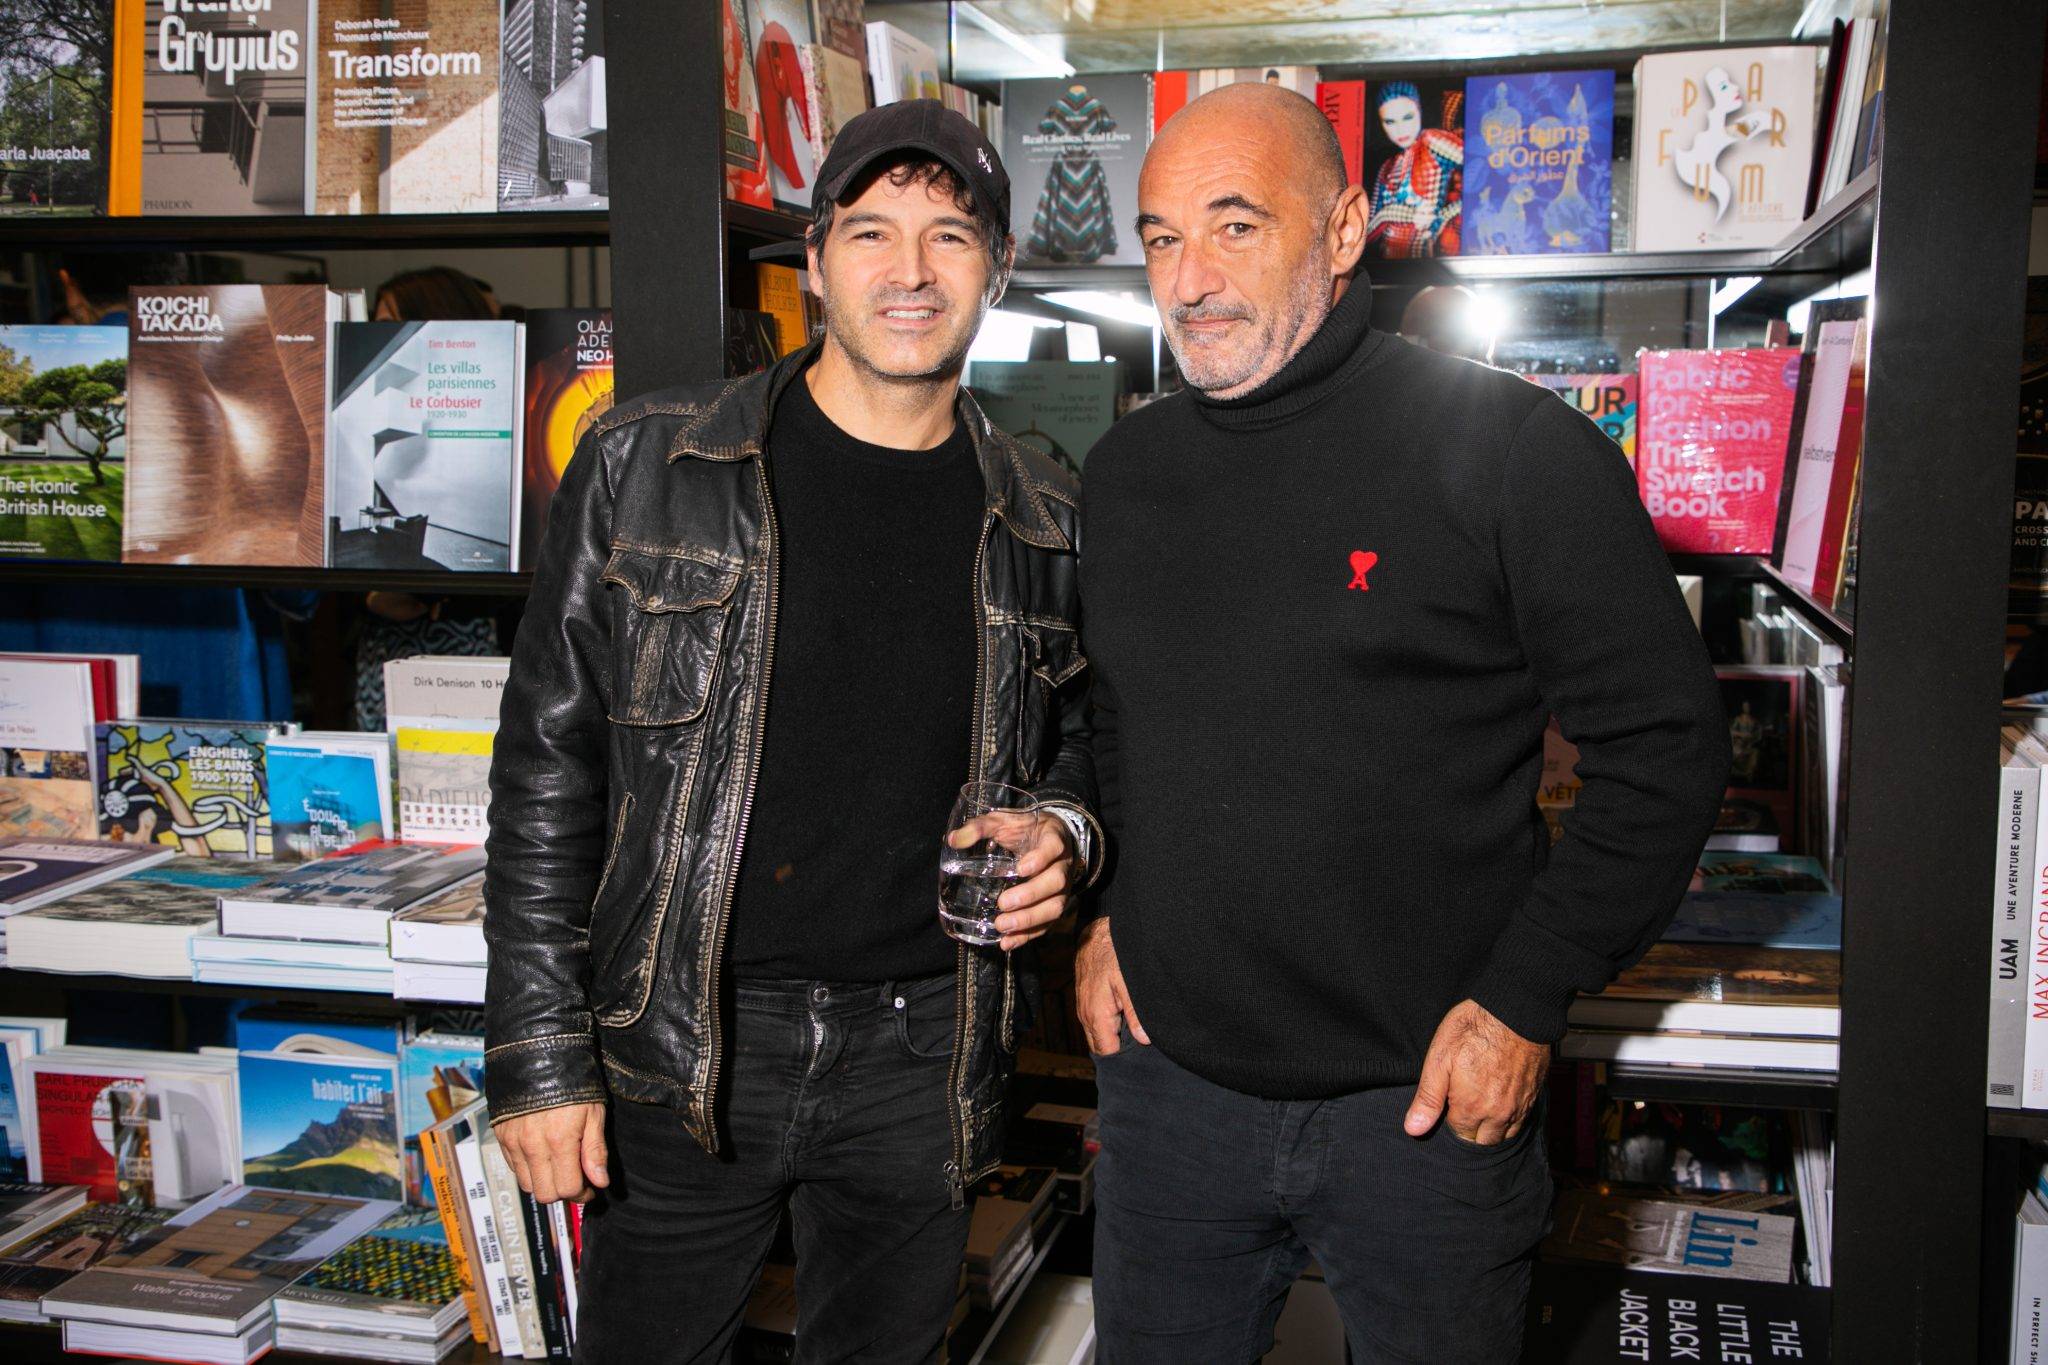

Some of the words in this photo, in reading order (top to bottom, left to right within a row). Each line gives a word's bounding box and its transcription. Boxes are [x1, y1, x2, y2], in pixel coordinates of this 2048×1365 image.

[159, 14, 299, 86] Gropius
[328, 47, 482, 79] Transform
[1485, 123, 1591, 147] Parfums
[29, 146, 91, 163] Juaçaba
[1489, 145, 1585, 169] d'Orient
[137, 296, 209, 315] KOICHI
[138, 314, 225, 332] TAKADA
[446, 340, 476, 349] Benton
[577, 350, 604, 362] NEO
[428, 362, 447, 374] Les
[450, 361, 482, 374] villas
[427, 377, 496, 394] parisiennes
[410, 397, 423, 409] Le
[427, 396, 482, 409] Corbusier
[1646, 414, 1772, 441] Fashion
[30, 478, 80, 495] Iconic
[52, 501, 107, 517] House
[1646, 493, 1729, 518] Book
[2014, 538, 2037, 546] AND
[414, 677, 433, 687] Dirk
[436, 677, 476, 688] Denison
[481, 680, 492, 689] 10
[2011, 789, 2023, 841] MODERNE
[2008, 844, 2020, 897] AVENTURE
[2006, 900, 2017, 920] UNE
[1999, 938, 2019, 980] UAM
[311, 1077, 355, 1104] habiter
[499, 1190, 523, 1249] CABIN
[510, 1251, 534, 1312] FEVER
[2033, 1297, 2041, 1308] IN
[1619, 1287, 1650, 1362] JACKET
[1667, 1298, 1701, 1360] BLACK
[1716, 1302, 1753, 1365] LITTLE
[2031, 1311, 2040, 1348] PERFECT
[1767, 1319, 1803, 1358] THE
